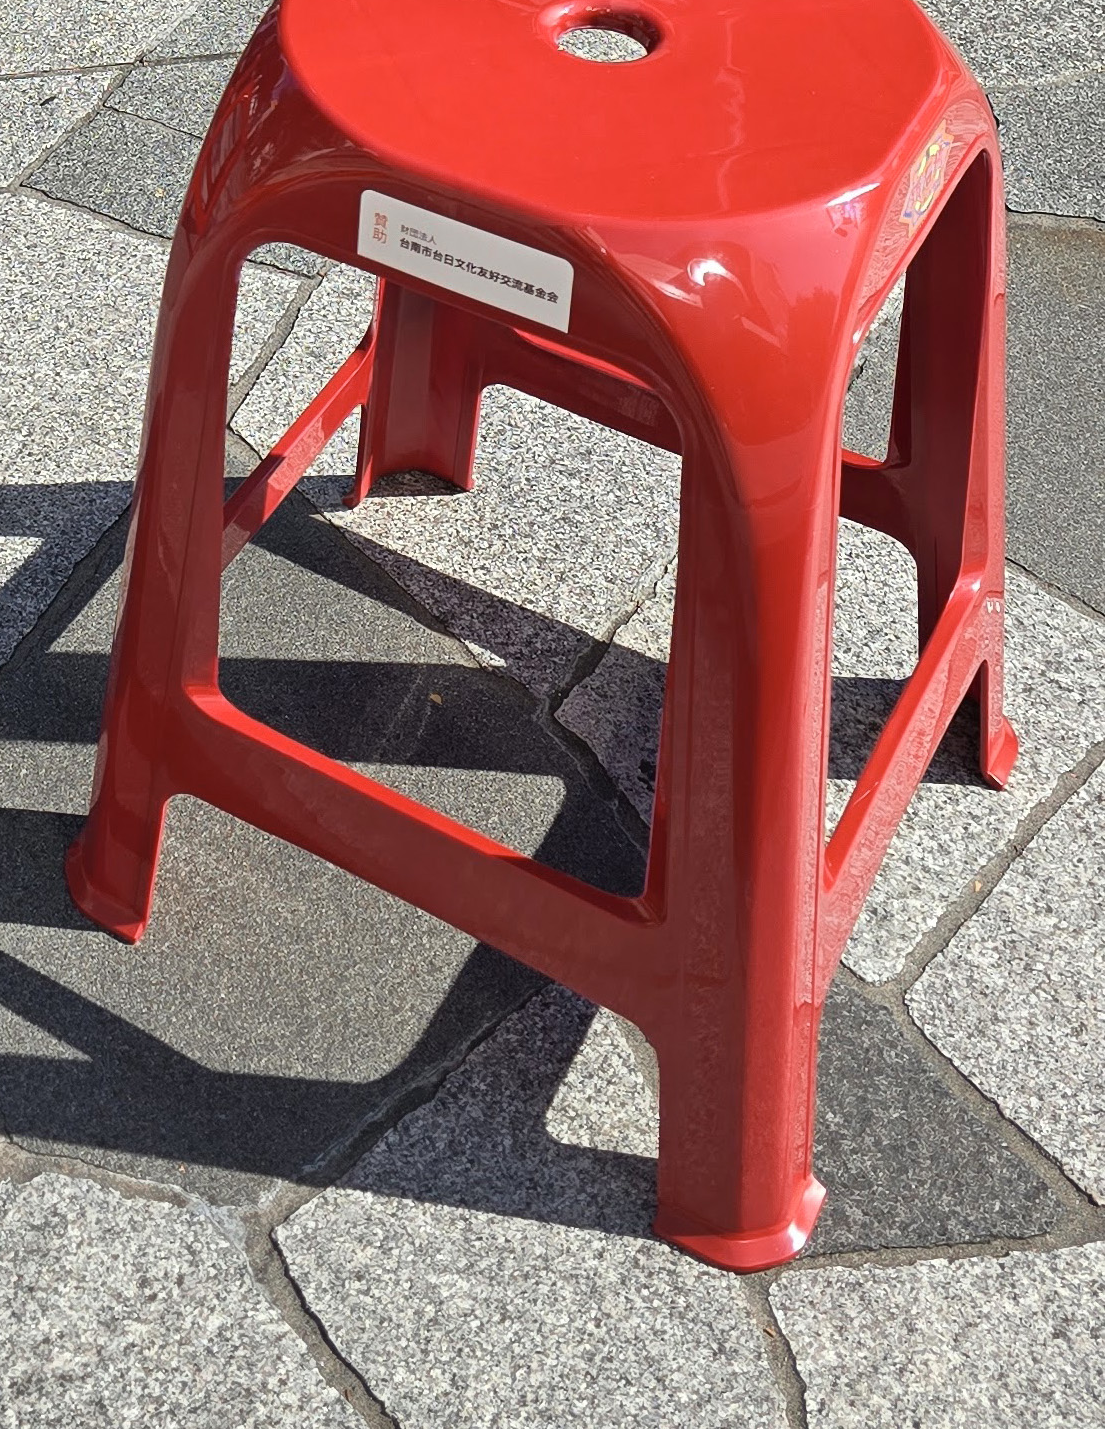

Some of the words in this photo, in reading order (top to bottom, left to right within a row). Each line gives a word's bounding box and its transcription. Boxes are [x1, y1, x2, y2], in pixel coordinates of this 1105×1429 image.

[400, 224, 437, 246] 財団法人
[399, 237, 559, 304] 台南市台日文化友好交流基金会
